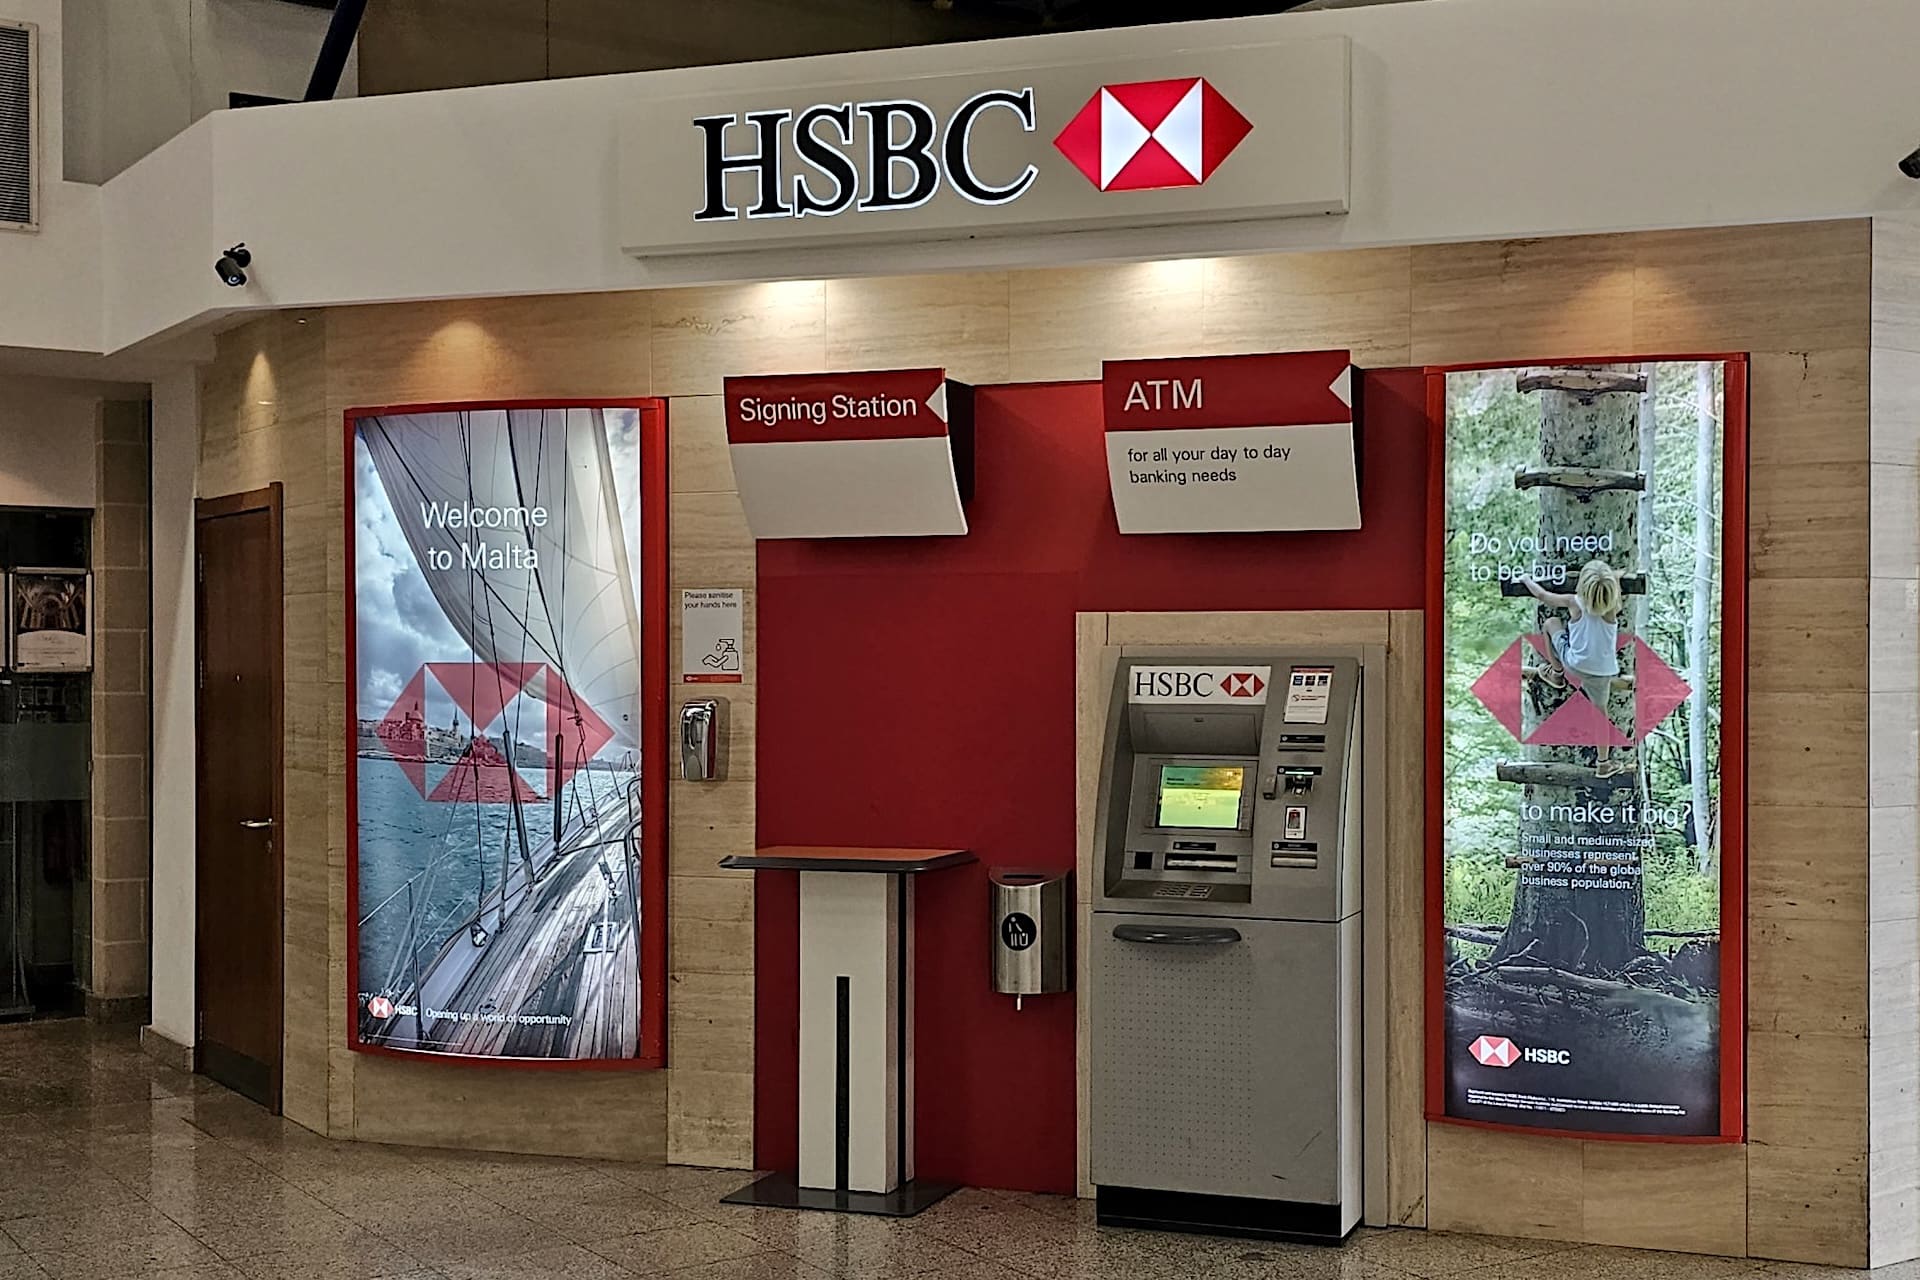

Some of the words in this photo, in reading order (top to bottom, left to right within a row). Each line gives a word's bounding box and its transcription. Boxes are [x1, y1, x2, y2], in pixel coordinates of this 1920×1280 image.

[693, 87, 1039, 222] HSBC
[1123, 378, 1202, 411] ATM
[739, 396, 826, 427] Signing
[831, 393, 917, 419] Station
[1127, 448, 1148, 462] for
[1152, 447, 1168, 462] all
[1172, 449, 1206, 464] your
[1210, 446, 1238, 463] day
[1243, 446, 1259, 459] to
[1263, 444, 1291, 461] day
[1129, 469, 1187, 486] banking
[1191, 467, 1237, 482] needs
[419, 500, 548, 529] Welcome
[1470, 532, 1501, 555] Do
[1508, 536, 1548, 557] you
[1556, 529, 1613, 552] need
[427, 546, 453, 571] to
[461, 541, 539, 570] Malta
[1470, 562, 1491, 582] to
[1498, 560, 1525, 583] be
[1532, 559, 1567, 585] big
[684, 591, 707, 599] Please
[684, 602, 699, 610] your
[1135, 671, 1214, 698] HSBC
[1520, 803, 1543, 821] to
[1550, 802, 1615, 824] make
[1621, 805, 1637, 824] it
[1643, 802, 1693, 829] big?
[1521, 833, 1551, 845] Small
[1554, 833, 1575, 845] and
[1577, 834, 1656, 848] medium-sized
[1521, 847, 1581, 860] businesses
[1583, 850, 1639, 863] represent
[1521, 863, 1545, 873] over
[1547, 862, 1573, 874] 90%
[1575, 862, 1587, 874] of
[1589, 863, 1608, 875] the
[1521, 876, 1569, 888] business
[1571, 878, 1634, 891] population.
[394, 1004, 419, 1017] HSBC
[425, 1009, 459, 1022] Opening
[460, 1011, 471, 1022] up
[480, 1012, 505, 1024] world
[518, 1014, 573, 1026] opportunity
[1524, 1047, 1571, 1065] HSBC
